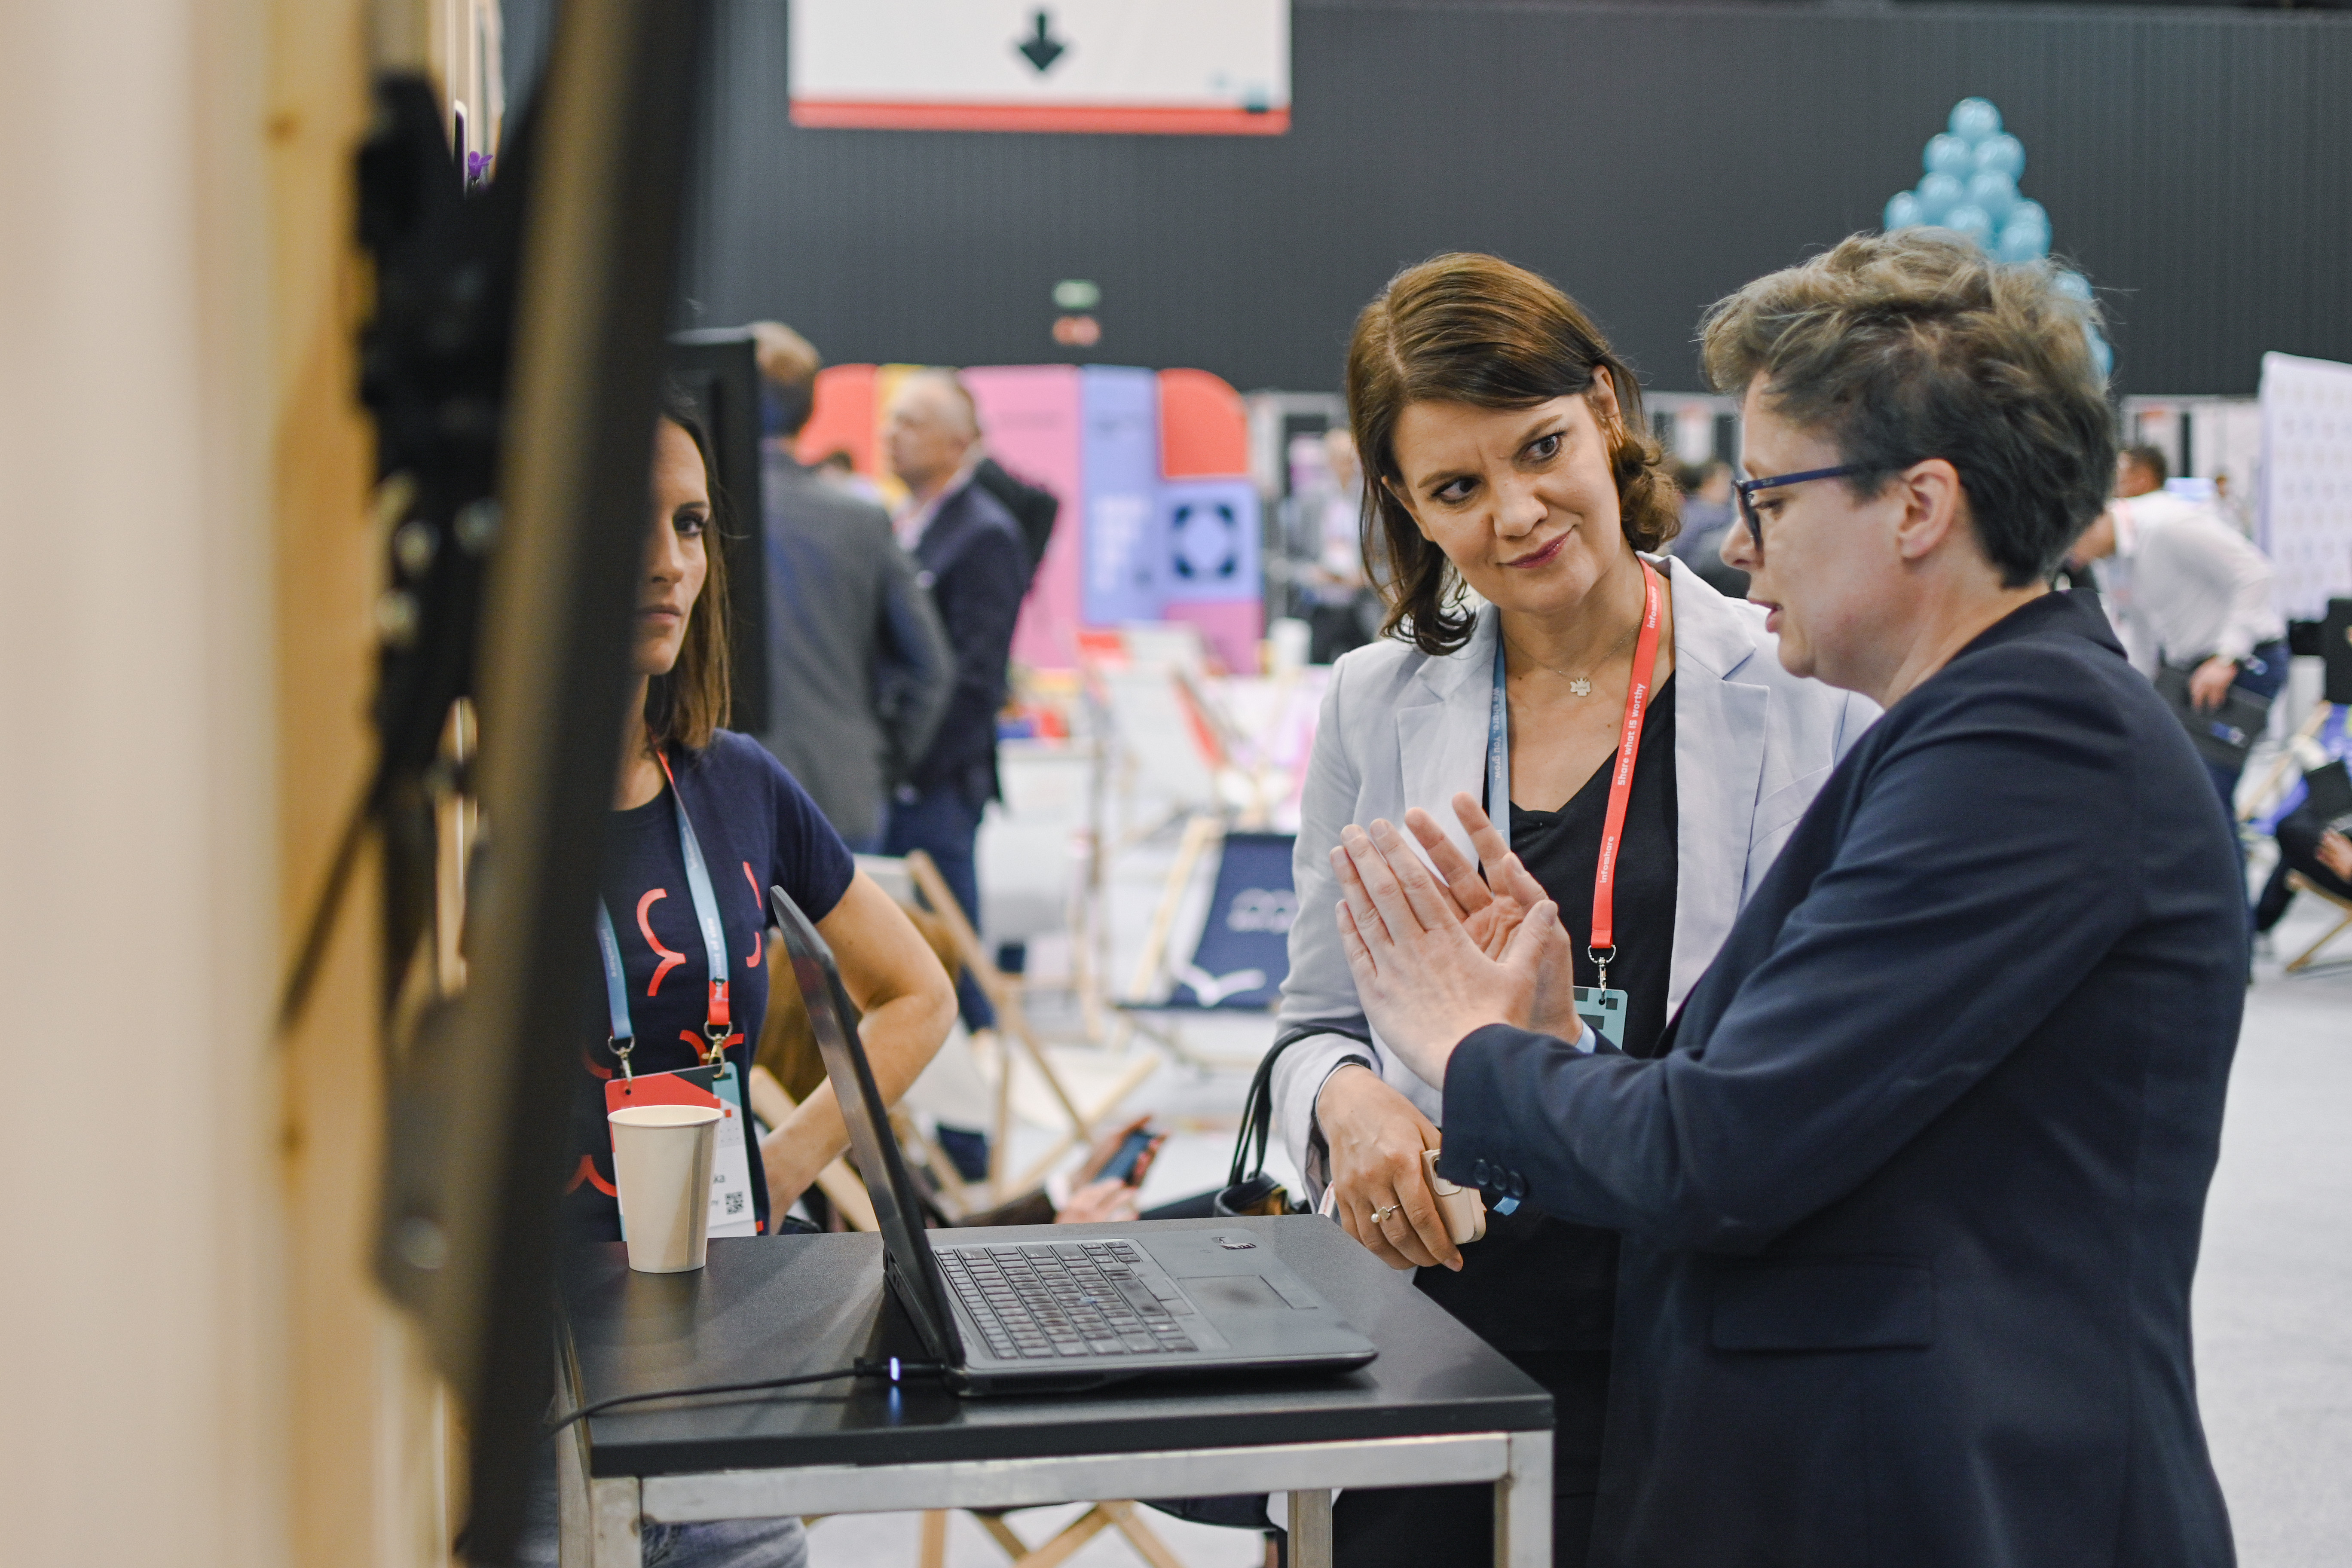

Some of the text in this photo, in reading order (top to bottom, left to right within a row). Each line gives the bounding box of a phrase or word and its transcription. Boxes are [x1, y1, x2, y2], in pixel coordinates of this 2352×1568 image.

[1493, 687, 1500, 701] We
[1494, 736, 1502, 753] You
[1618, 758, 1630, 786] Share
[1624, 731, 1636, 755] what
[1632, 683, 1646, 718] worthy
[1492, 755, 1502, 780] grow.
